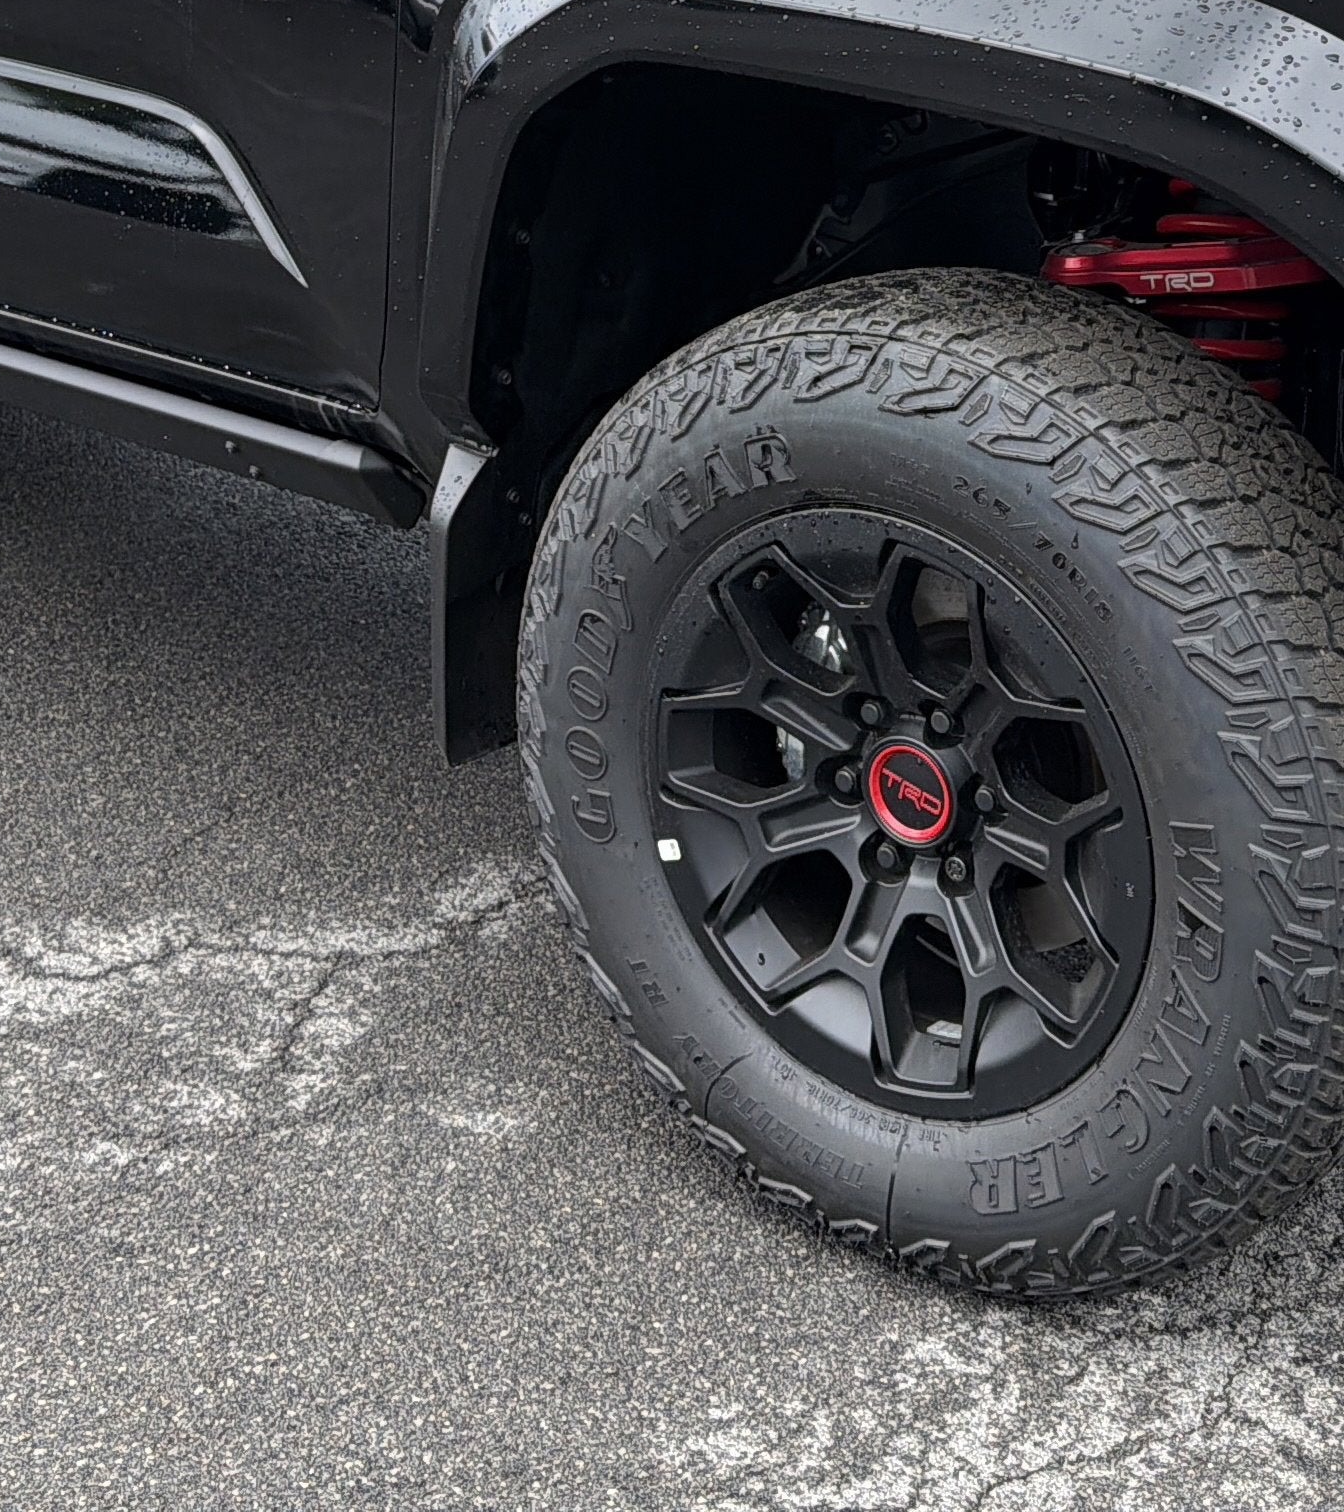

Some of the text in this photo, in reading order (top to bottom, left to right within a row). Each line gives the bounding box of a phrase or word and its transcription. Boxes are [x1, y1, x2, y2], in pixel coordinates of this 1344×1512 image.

[1140, 272, 1216, 293] TRD
[881, 767, 943, 817] TRD
[965, 820, 1226, 1217] WRANGLER
